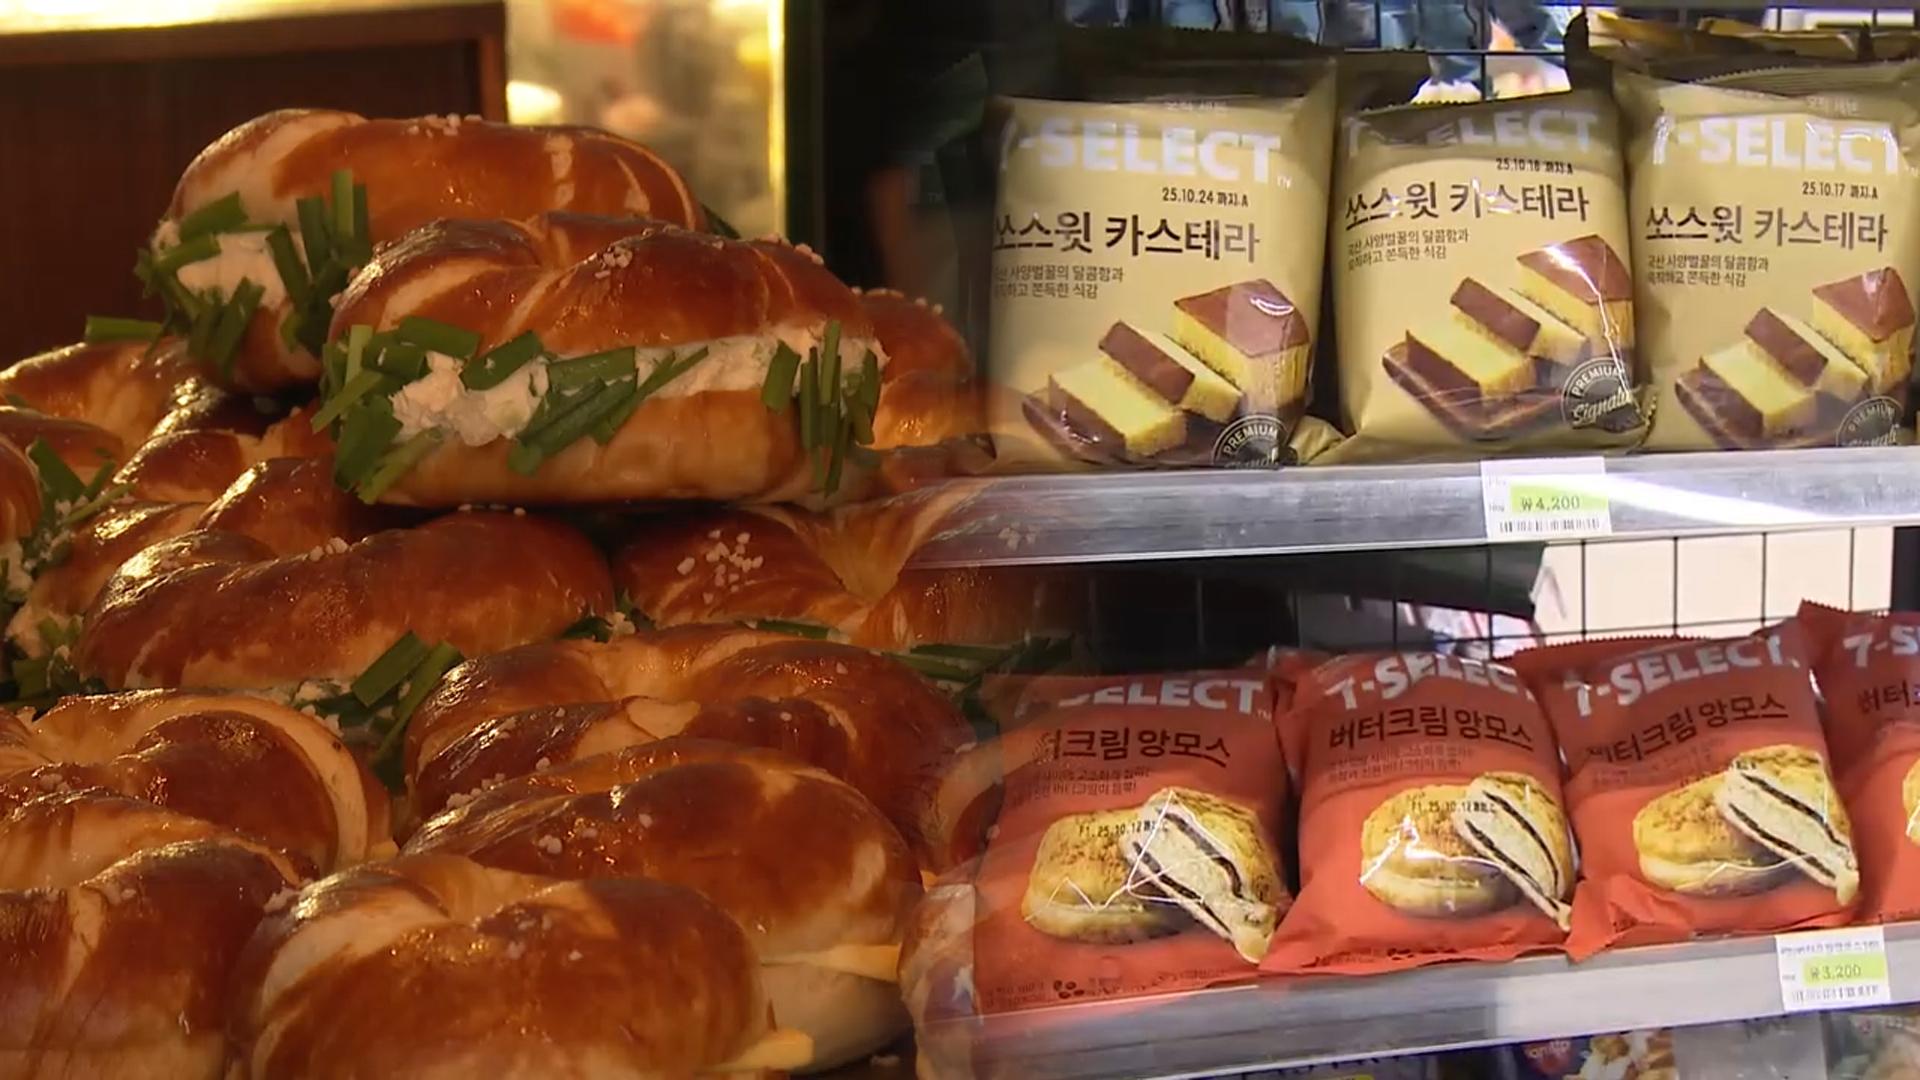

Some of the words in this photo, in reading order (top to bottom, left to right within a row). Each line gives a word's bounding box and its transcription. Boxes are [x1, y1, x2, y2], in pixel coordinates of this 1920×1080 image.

[1162, 186, 1214, 204] 25.10.24
[1345, 182, 1440, 232] 쏘스윗
[1450, 177, 1590, 222] 카스테라
[1802, 181, 1846, 198] 25.10.17
[1105, 214, 1261, 264] 카스테라
[1646, 205, 1743, 244] 쏘스윗
[1754, 207, 1888, 252] 카스테라
[1072, 282, 1099, 300] 식감
[1222, 423, 1279, 457] PREMIUM
[1842, 623, 1920, 668] 7-S
[1563, 635, 1786, 717] 7-SELECT
[1700, 692, 1789, 728] 앙모스
[1858, 680, 1920, 715] 버터
[1329, 706, 1449, 750] 버터크림
[1455, 709, 1534, 751] 앙모스
[1137, 730, 1231, 768] 앙모스
